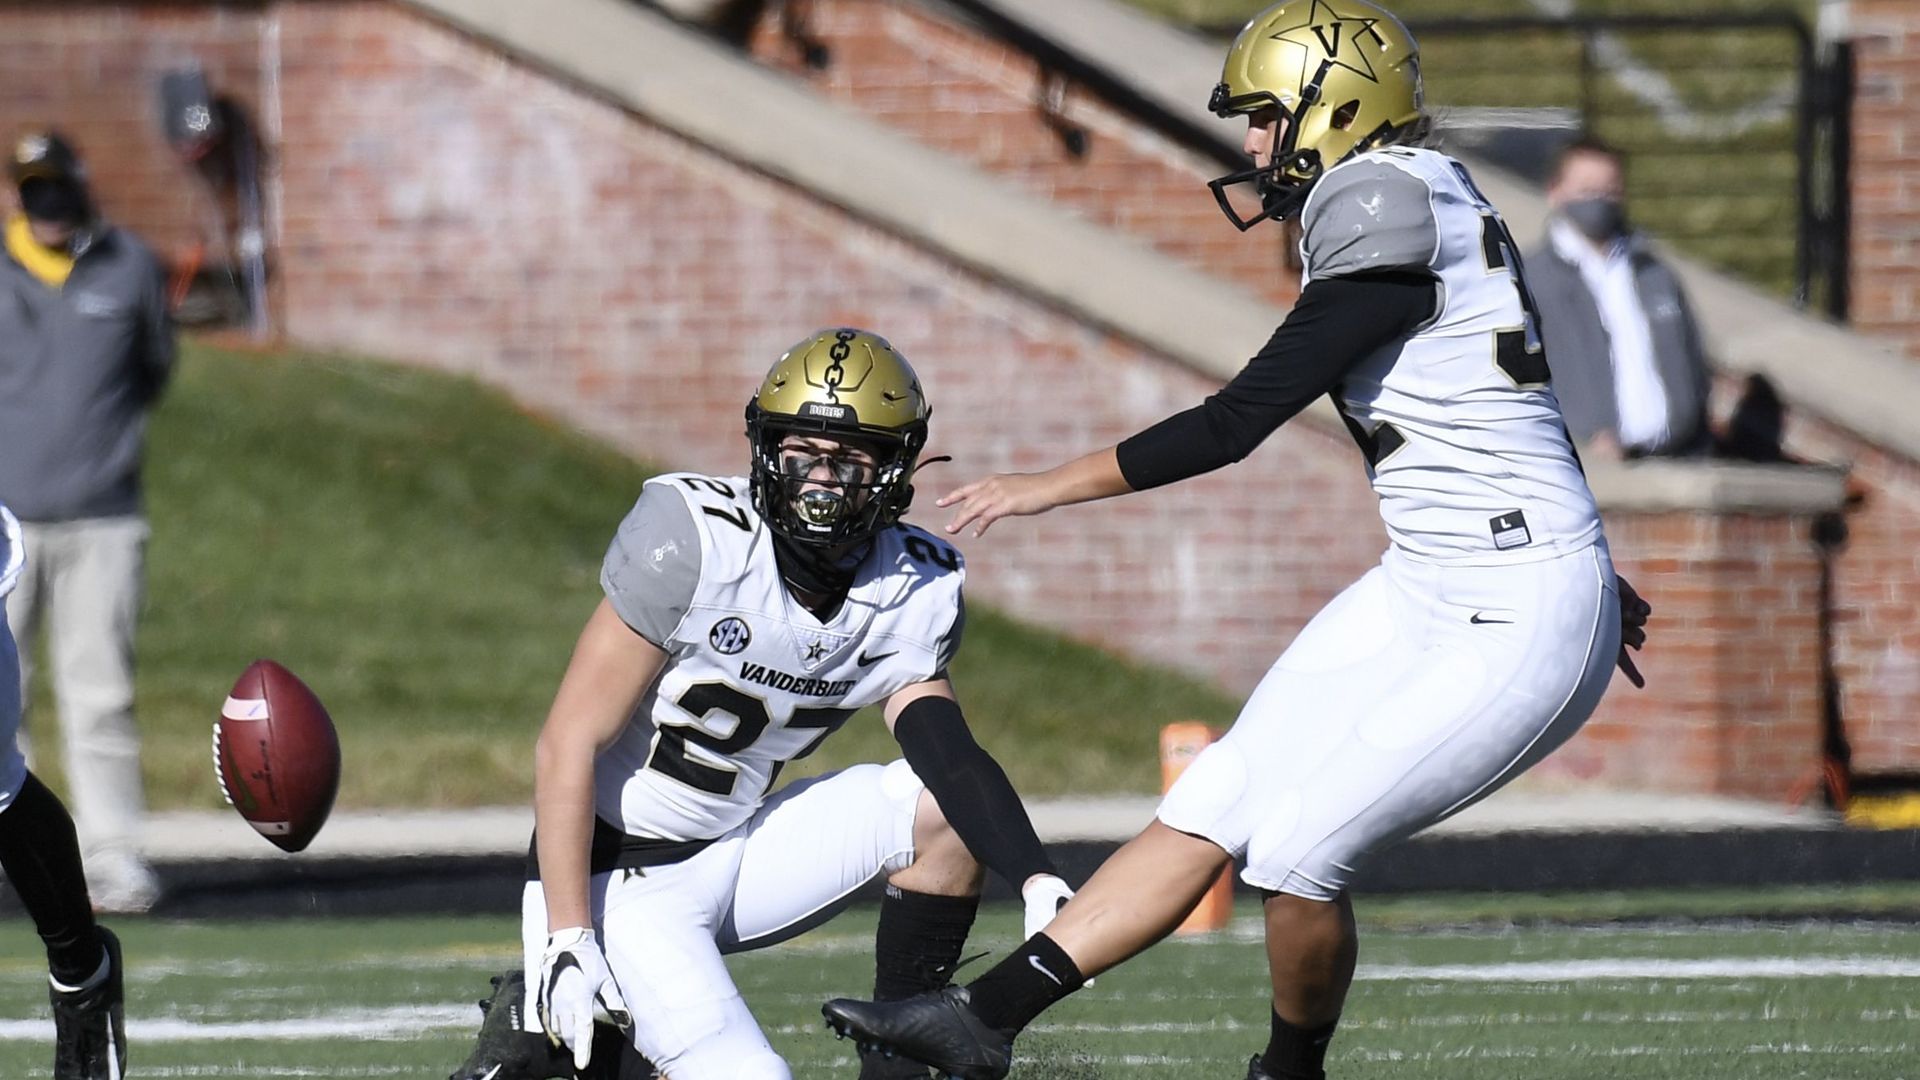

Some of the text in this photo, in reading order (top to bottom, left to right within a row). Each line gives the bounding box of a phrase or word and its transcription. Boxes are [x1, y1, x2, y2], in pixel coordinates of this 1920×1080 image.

[1310, 22, 1342, 58] V
[677, 478, 753, 533] 27
[1500, 517, 1512, 529] L
[904, 535, 958, 573] 2
[711, 619, 748, 653] SEC
[739, 661, 857, 698] VANDERBILT
[647, 678, 861, 797] 27
